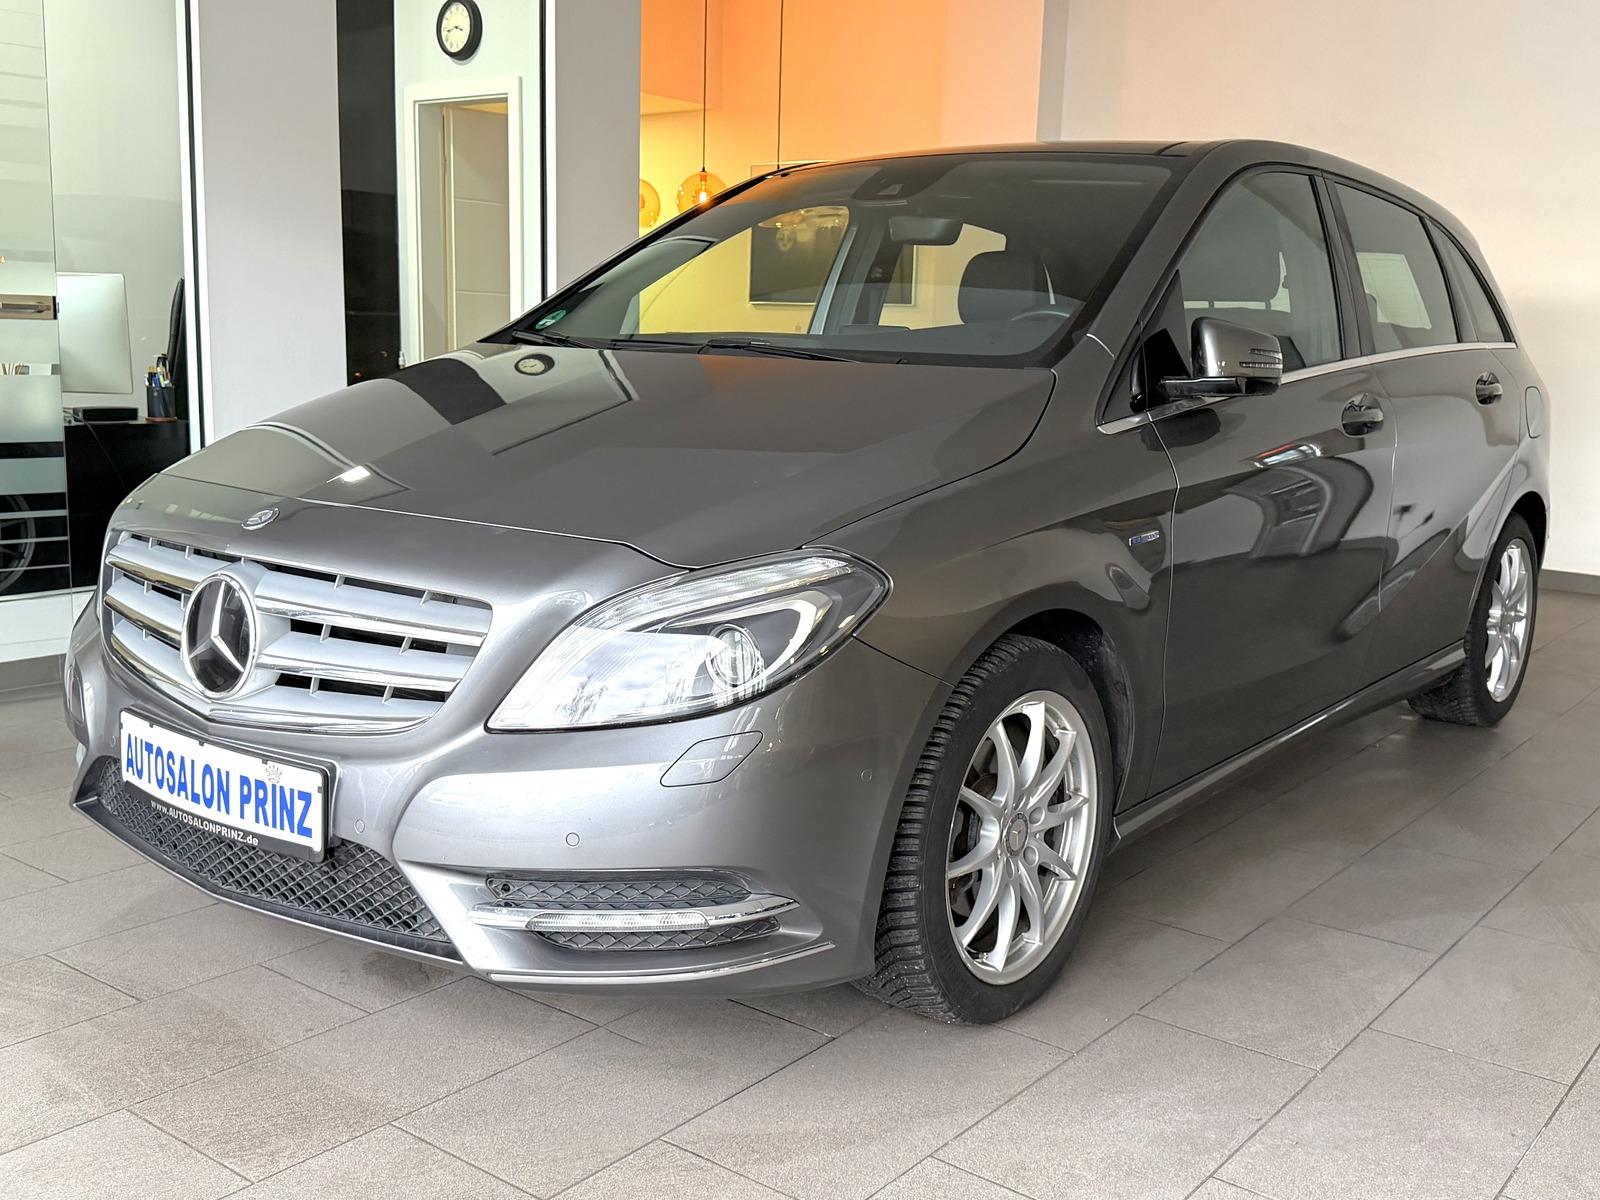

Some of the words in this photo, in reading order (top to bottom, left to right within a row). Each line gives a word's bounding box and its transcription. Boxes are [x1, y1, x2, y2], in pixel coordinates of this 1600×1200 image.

[126, 733, 230, 815] AUTOSALON
[240, 775, 313, 838] PRINZ
[151, 800, 259, 846] www.AUTOSALONPRINZ.de
